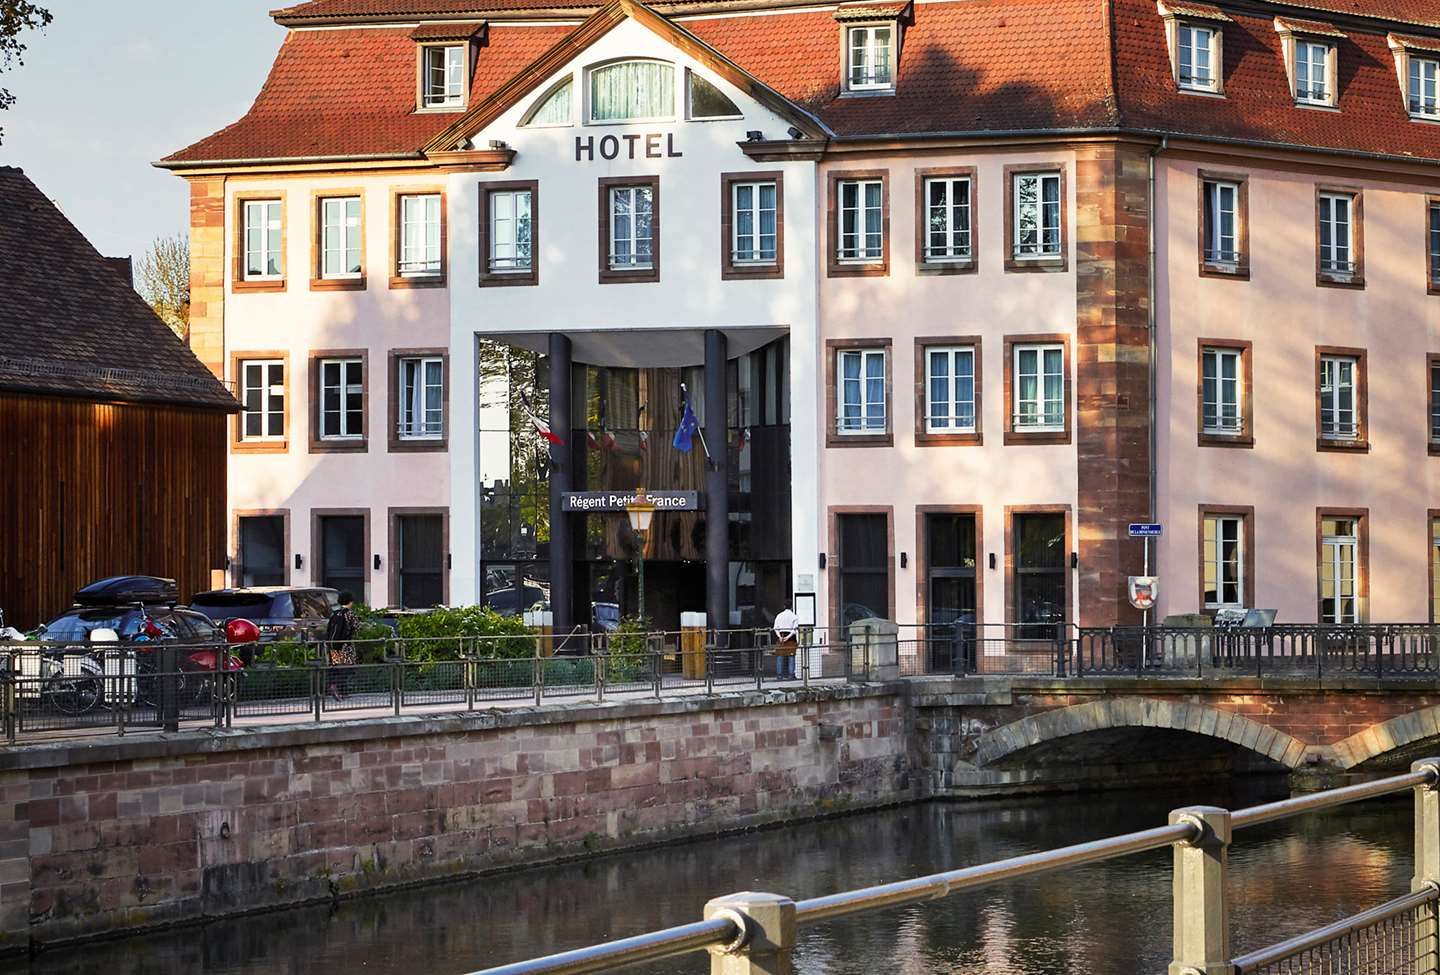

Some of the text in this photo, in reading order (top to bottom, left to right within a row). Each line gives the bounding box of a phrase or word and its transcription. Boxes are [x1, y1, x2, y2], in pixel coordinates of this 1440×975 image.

[575, 133, 683, 161] HOTEL
[569, 495, 606, 510] Régent
[609, 494, 640, 506] Petit
